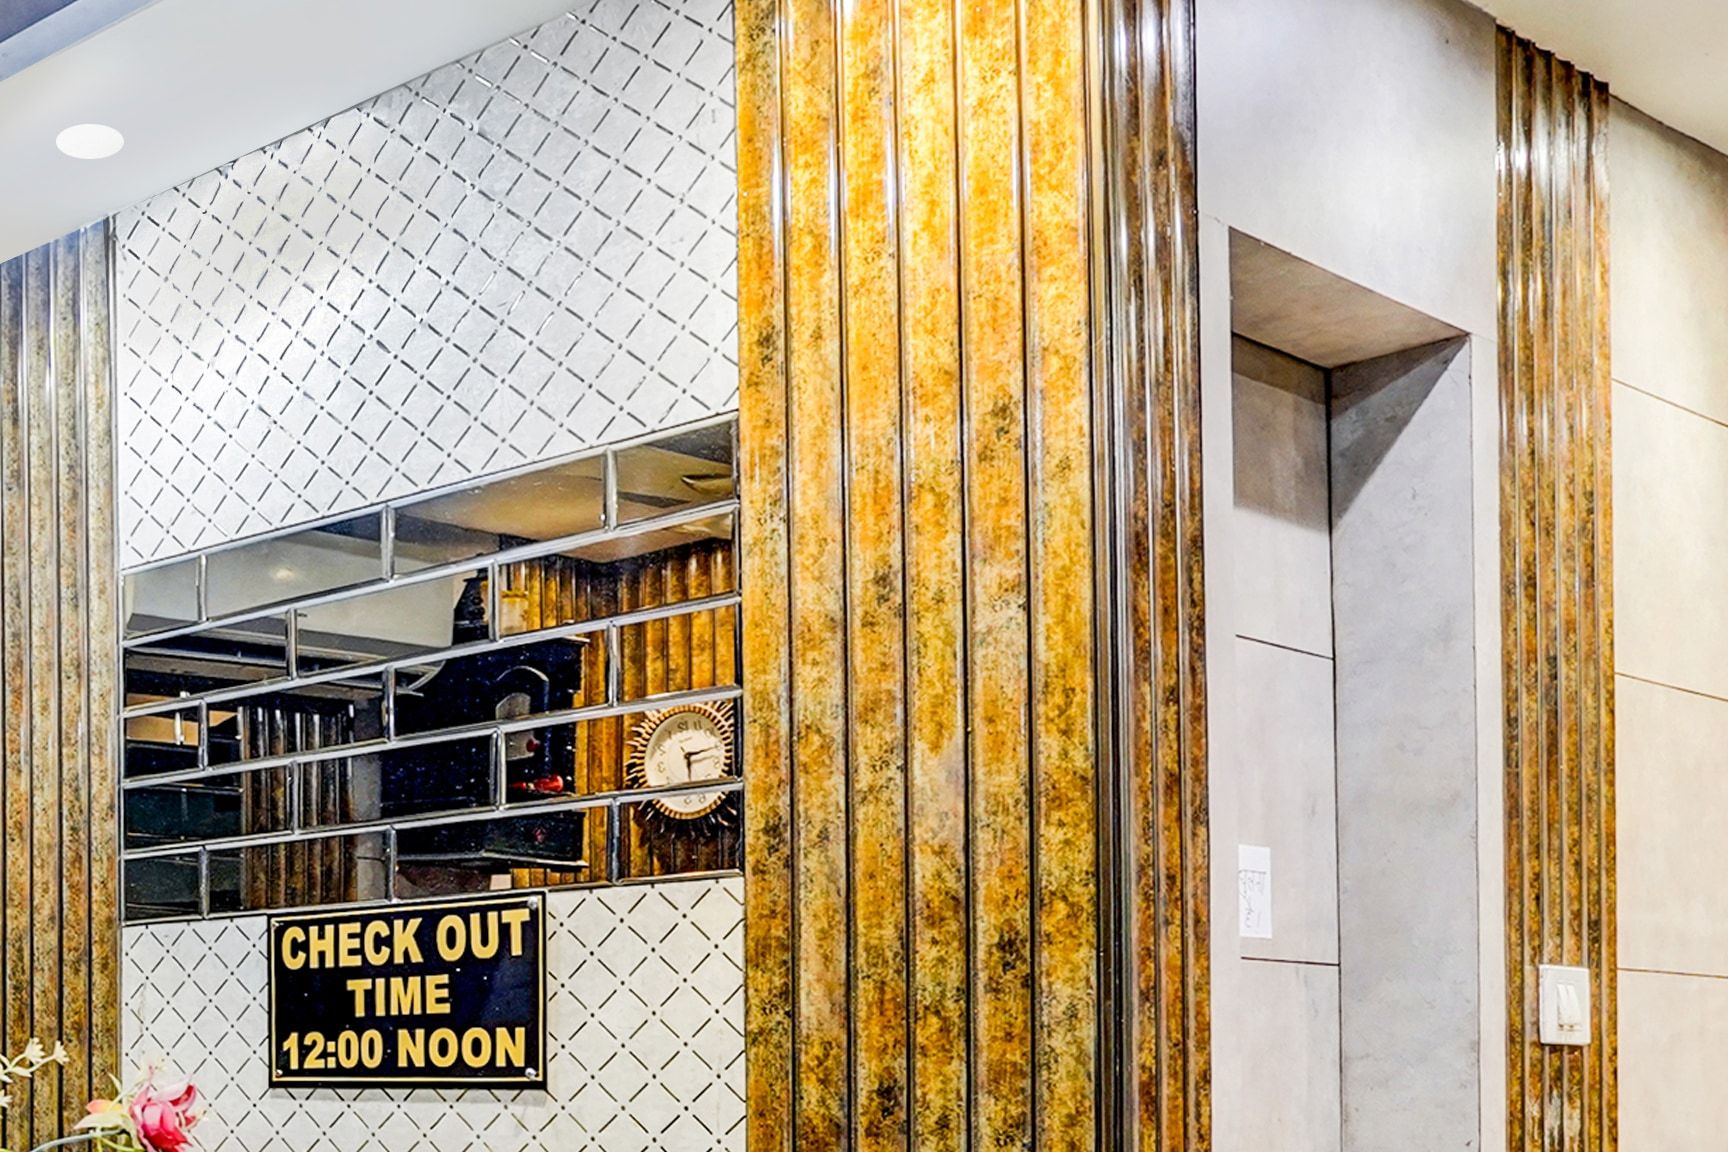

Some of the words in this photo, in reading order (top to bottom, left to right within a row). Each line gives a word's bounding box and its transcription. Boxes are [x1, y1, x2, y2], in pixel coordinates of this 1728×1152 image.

[281, 917, 423, 970] CHECK
[436, 909, 530, 961] OUT
[346, 974, 451, 1018] TIME
[282, 1029, 383, 1069] 12:00
[397, 1027, 526, 1068] NOON
